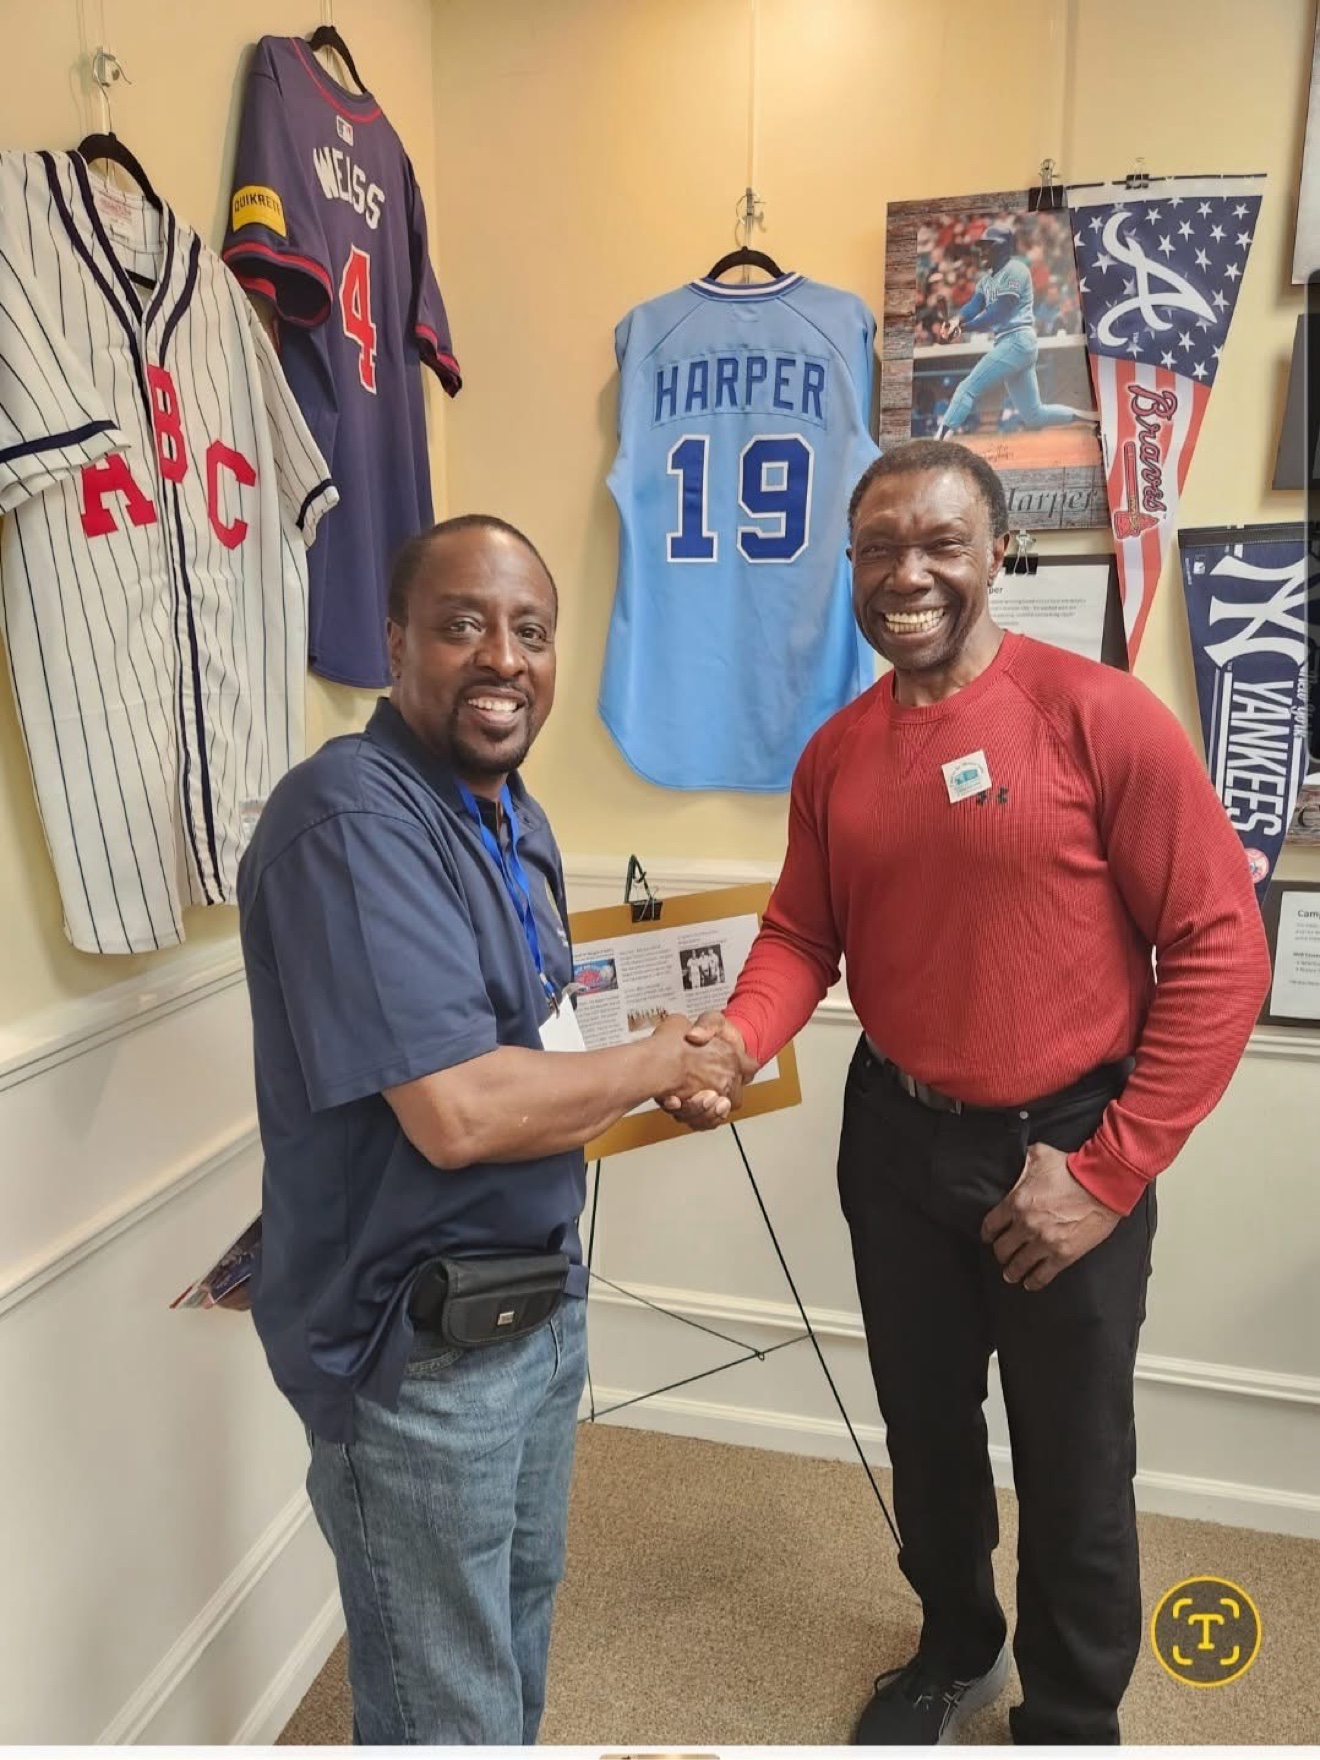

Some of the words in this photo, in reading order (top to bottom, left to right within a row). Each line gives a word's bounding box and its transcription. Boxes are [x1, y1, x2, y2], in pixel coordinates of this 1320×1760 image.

[313, 146, 385, 230] WEISS
[339, 243, 378, 395] 4
[1098, 211, 1217, 346] A
[655, 355, 826, 422] HARPER
[1128, 382, 1179, 512] Braves
[665, 433, 816, 565] 19
[1224, 680, 1294, 836] YANKEES
